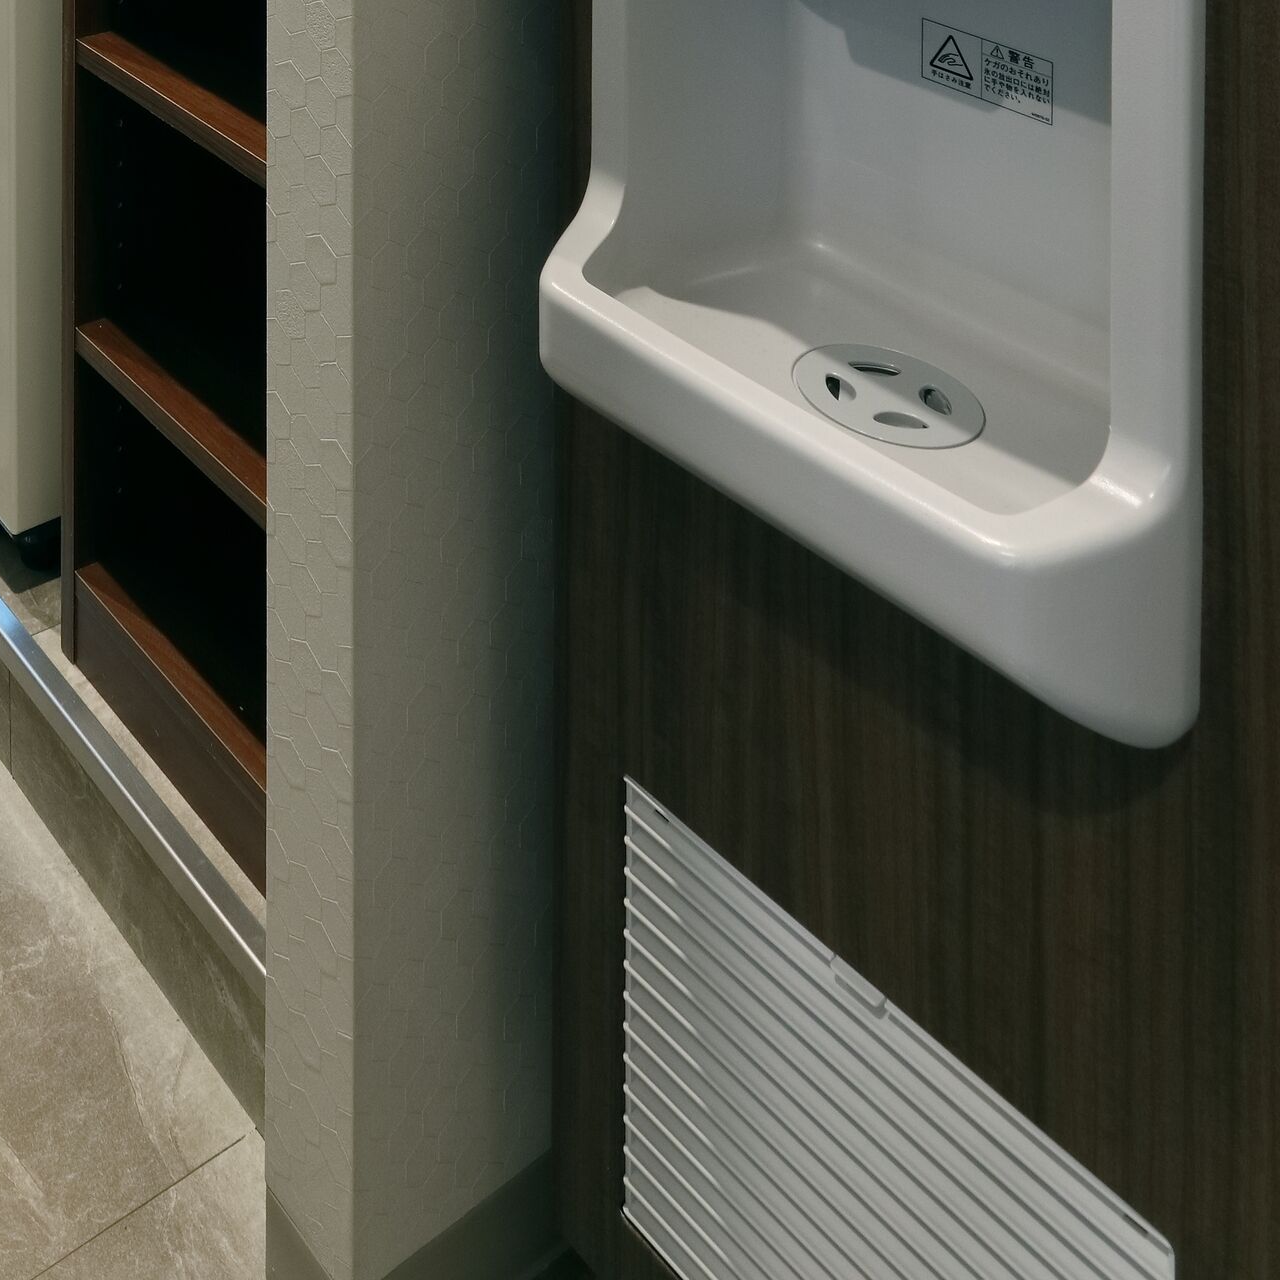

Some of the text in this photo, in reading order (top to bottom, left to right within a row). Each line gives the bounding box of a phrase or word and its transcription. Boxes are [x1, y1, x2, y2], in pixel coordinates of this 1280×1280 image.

[1008, 49, 1035, 70] 警告
[984, 58, 1049, 87] ケガのおそれあり
[984, 75, 1050, 104] に手や物を入れない
[984, 83, 1021, 103] でください。
